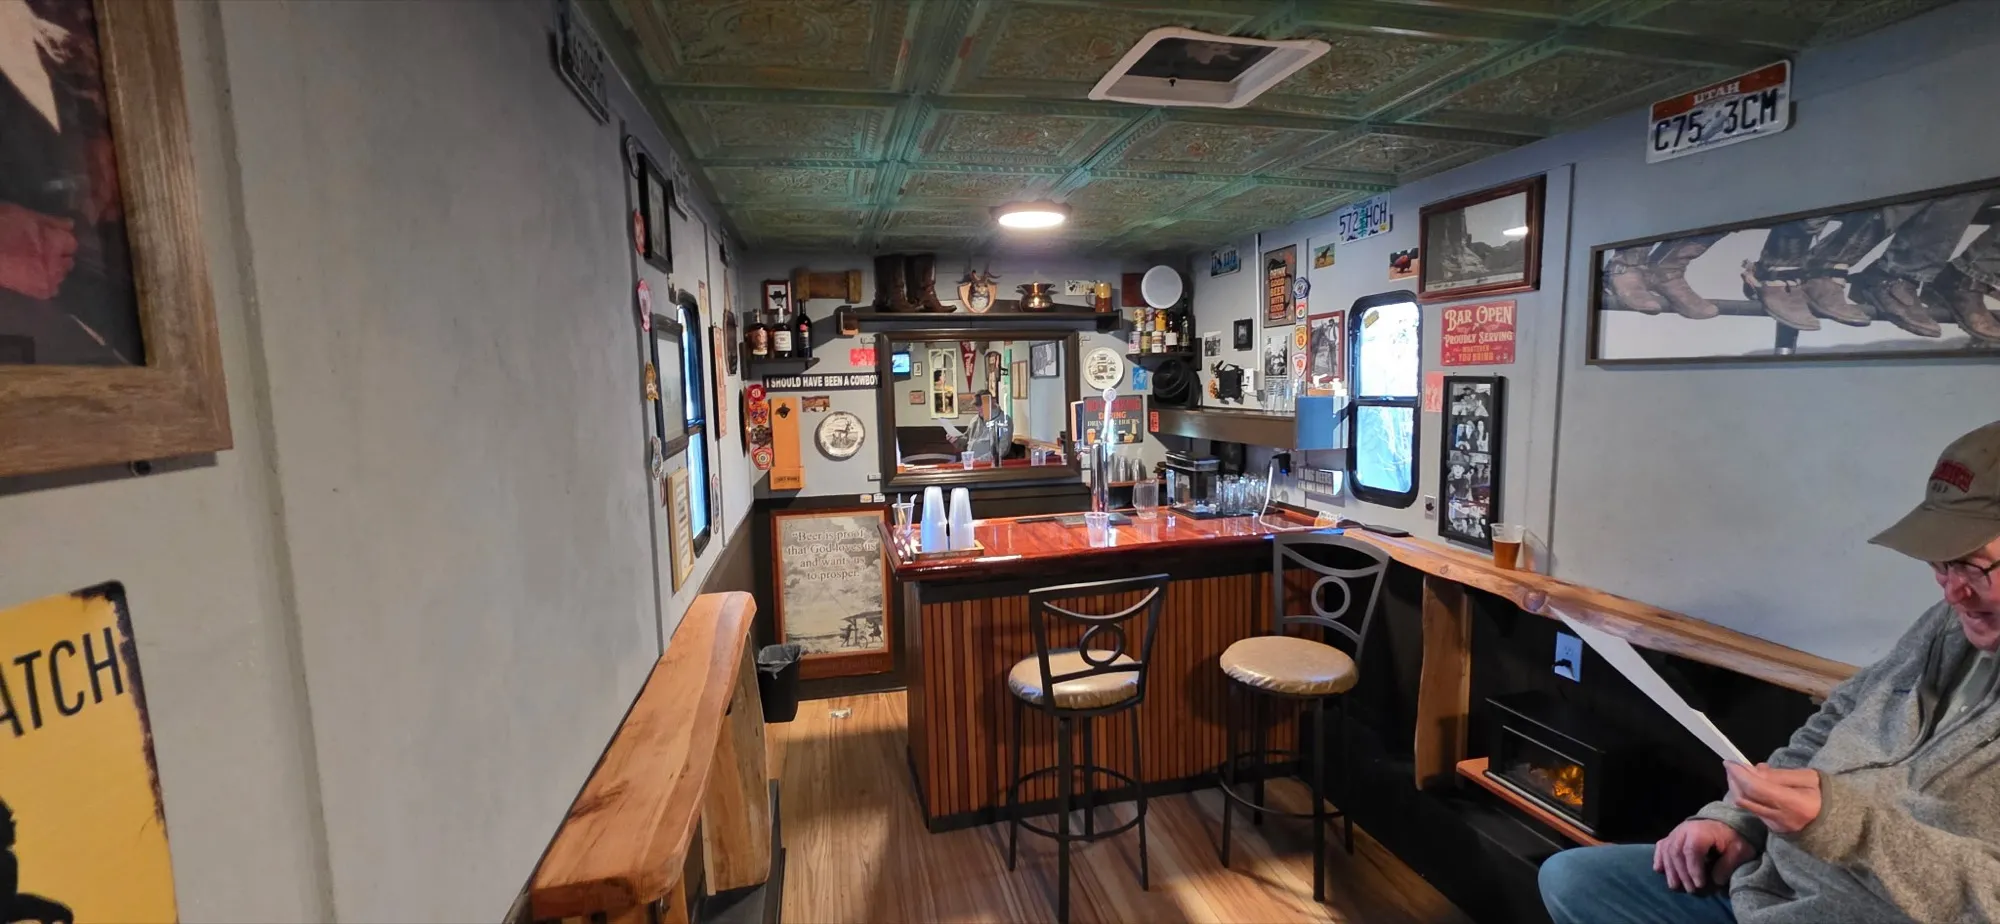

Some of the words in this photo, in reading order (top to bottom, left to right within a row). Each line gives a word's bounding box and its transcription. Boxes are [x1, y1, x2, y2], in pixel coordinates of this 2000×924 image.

[1693, 81, 1740, 106] UTAH
[1654, 109, 1704, 151] C75
[1724, 87, 1778, 134] 3CM
[1339, 211, 1359, 236] 572
[1366, 201, 1388, 228] HCH
[1271, 286, 1285, 297] BEER
[1445, 309, 1472, 331] BAR
[1476, 305, 1513, 325] OPEN
[1444, 334, 1477, 344] PROUDLY
[1478, 331, 1513, 344] SERVING
[1459, 353, 1471, 361] YOU
[771, 376, 801, 388] SHOULD
[802, 376, 823, 387] HAVE
[824, 375, 843, 386] BEEN
[844, 375, 850, 386] A
[850, 374, 879, 386] COWBOY
[1098, 411, 1127, 420] DRING
[825, 530, 834, 540] is
[836, 529, 865, 542] proof
[788, 545, 807, 555] that
[810, 543, 832, 554] God
[834, 543, 861, 553] loves
[864, 543, 877, 551] us
[800, 557, 818, 568] and
[821, 557, 846, 566] want
[807, 572, 817, 580] to
